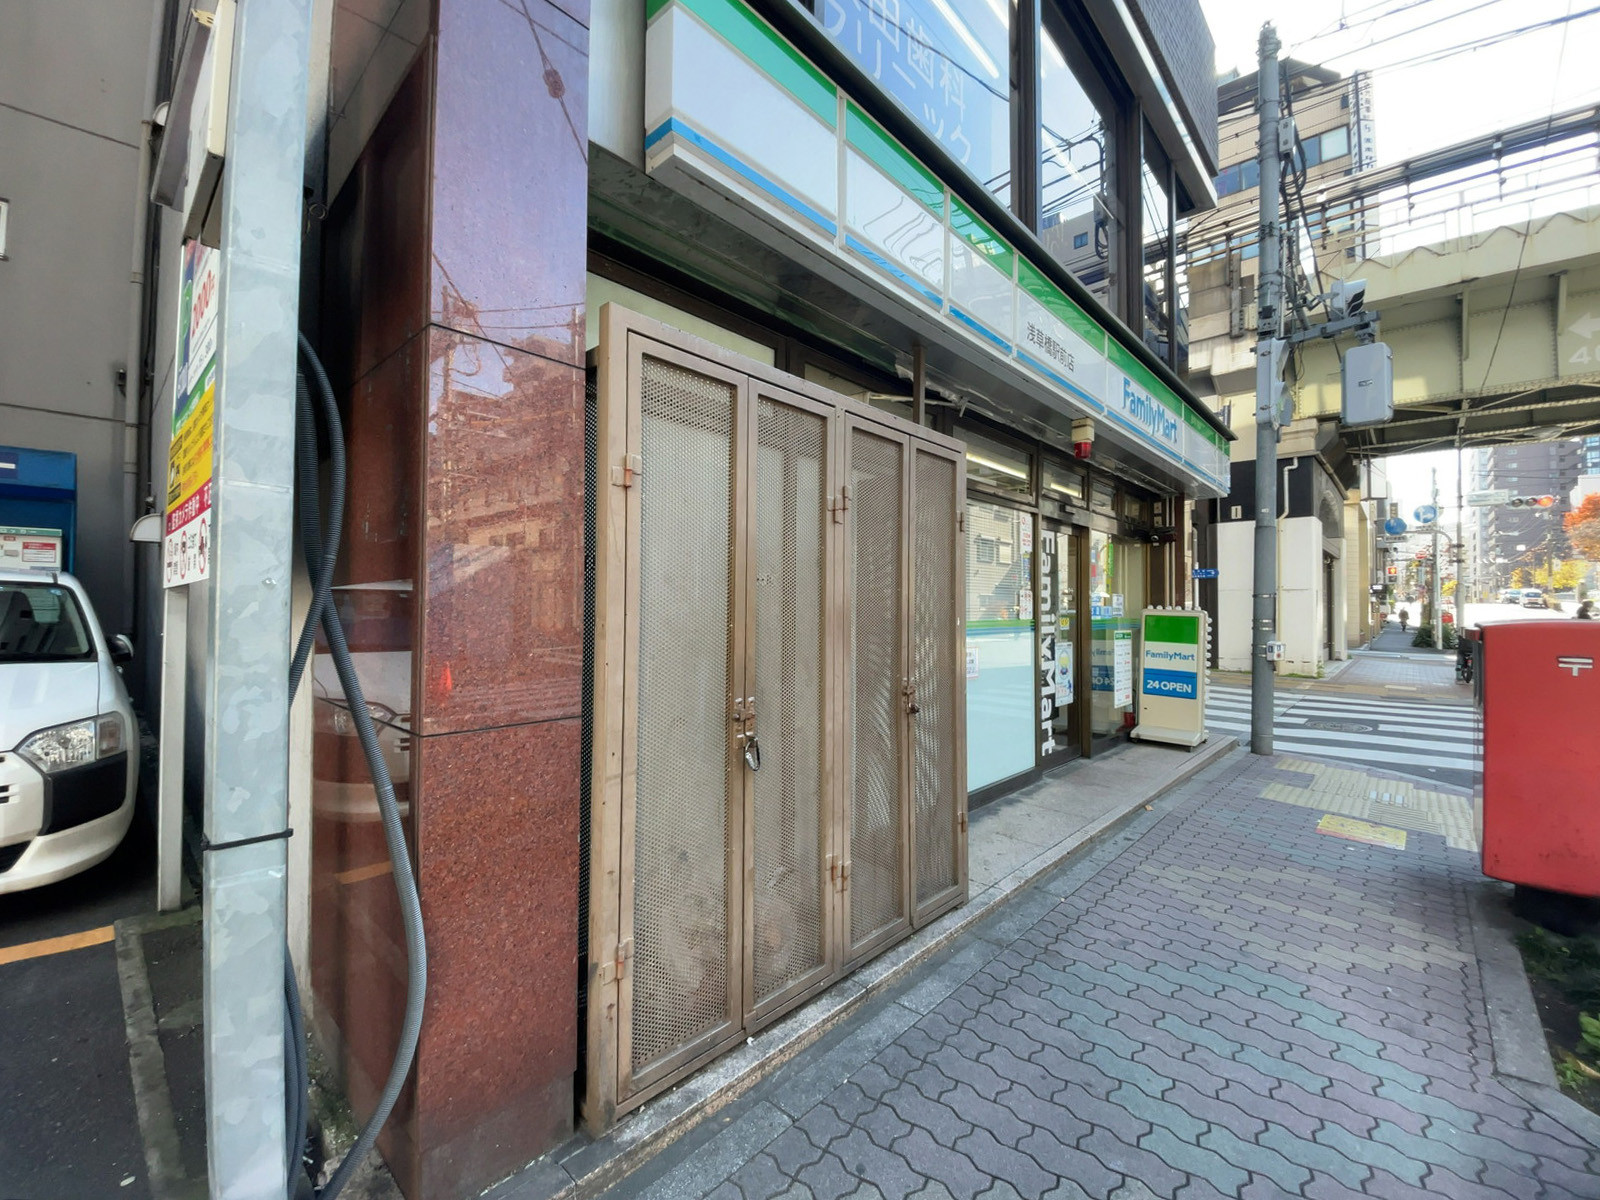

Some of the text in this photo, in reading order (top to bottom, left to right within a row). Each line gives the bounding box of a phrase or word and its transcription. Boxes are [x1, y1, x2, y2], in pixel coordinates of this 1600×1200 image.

[1026, 321, 1075, 373] 浅草橋駅前店
[1122, 376, 1178, 444] FamilyMart
[1040, 530, 1056, 757] FamilyMart
[1145, 649, 1195, 662] FamilyMart
[1146, 679, 1192, 694] 24 OPEN
